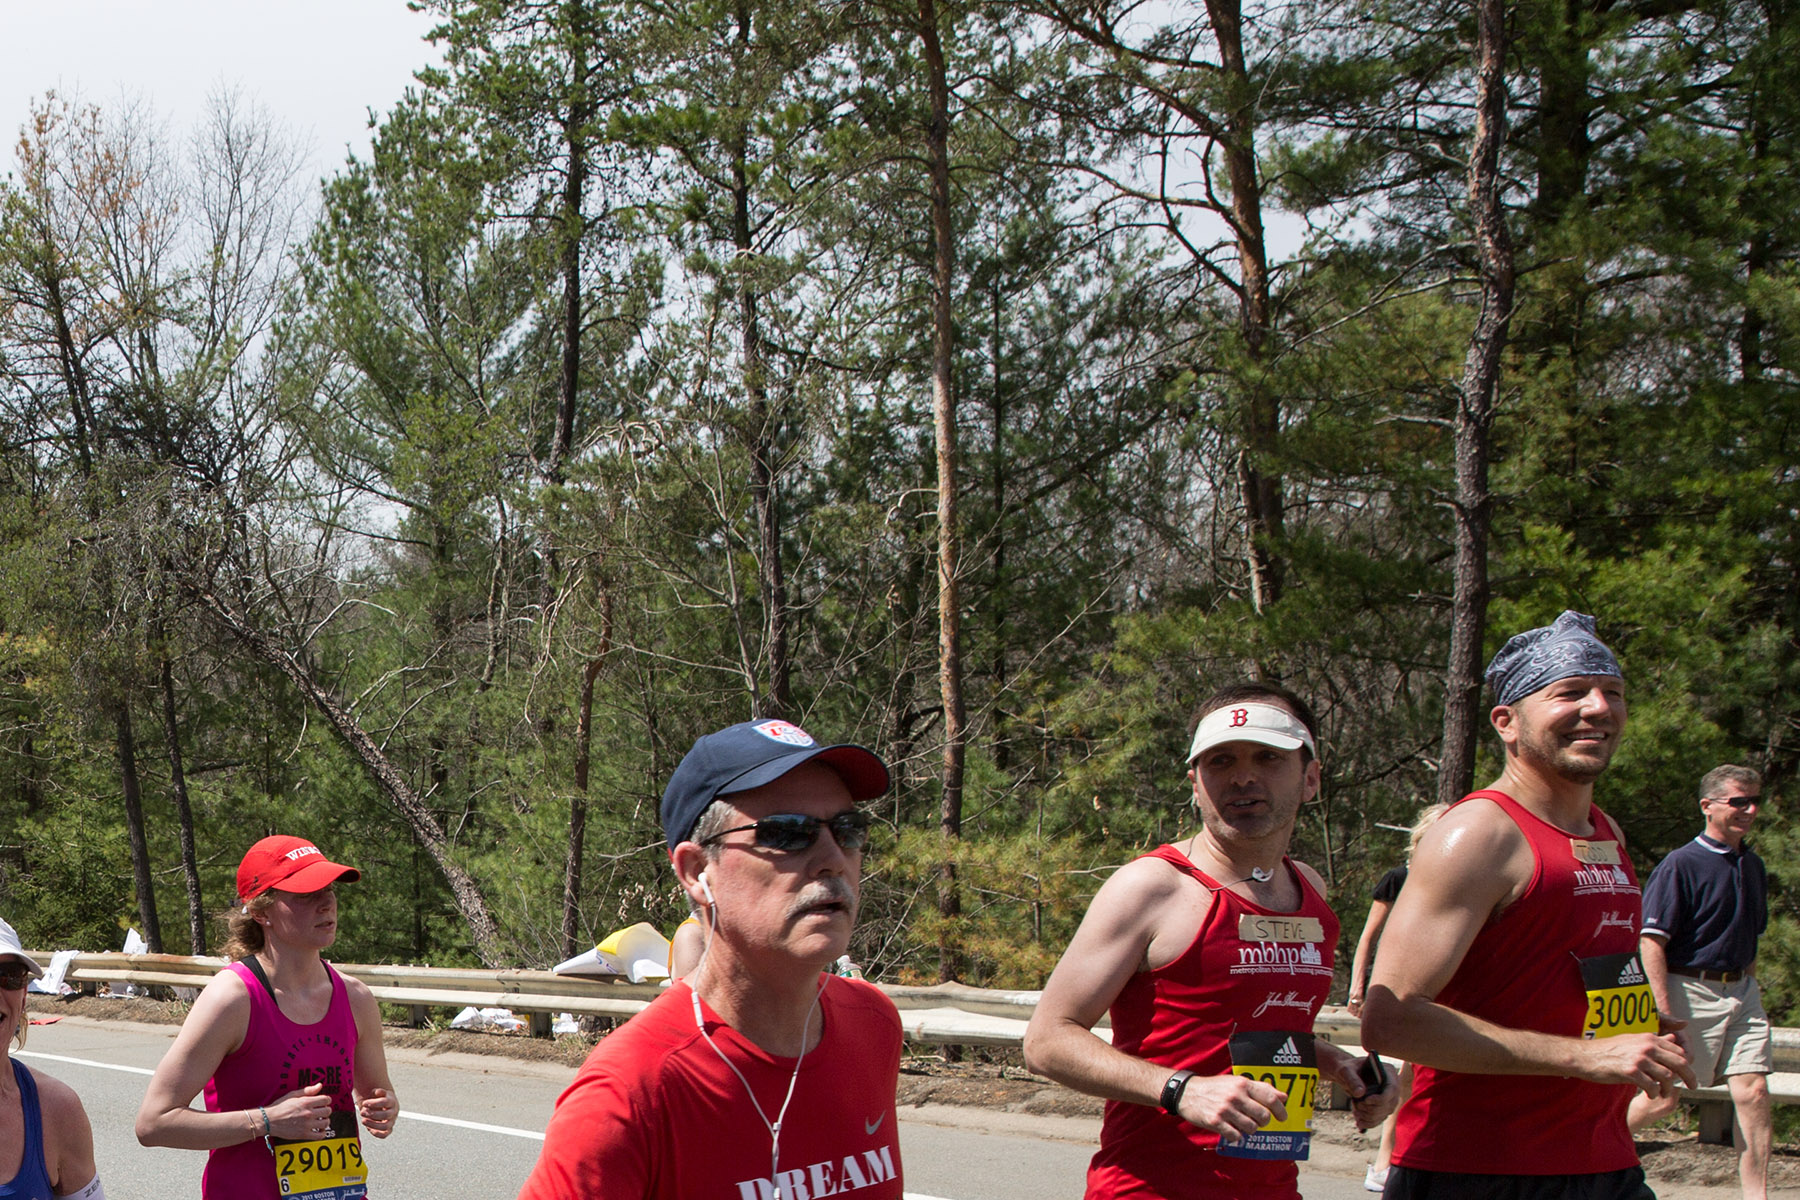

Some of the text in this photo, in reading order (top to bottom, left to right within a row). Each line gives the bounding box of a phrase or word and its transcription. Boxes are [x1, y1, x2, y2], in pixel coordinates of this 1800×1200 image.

[1229, 708, 1248, 727] B
[1255, 919, 1306, 940] STEVE
[1238, 941, 1300, 976] mbhp
[1618, 973, 1644, 985] adidas
[1272, 1053, 1302, 1065] adidas
[1240, 1072, 1317, 1108] 773
[1245, 1141, 1292, 1151] MARATHON
[1266, 1135, 1292, 1143] BOSTON
[279, 1143, 363, 1176] 29019
[281, 1178, 290, 1193] 6
[301, 1193, 313, 1200] 2017
[313, 1191, 335, 1200] BOSTON
